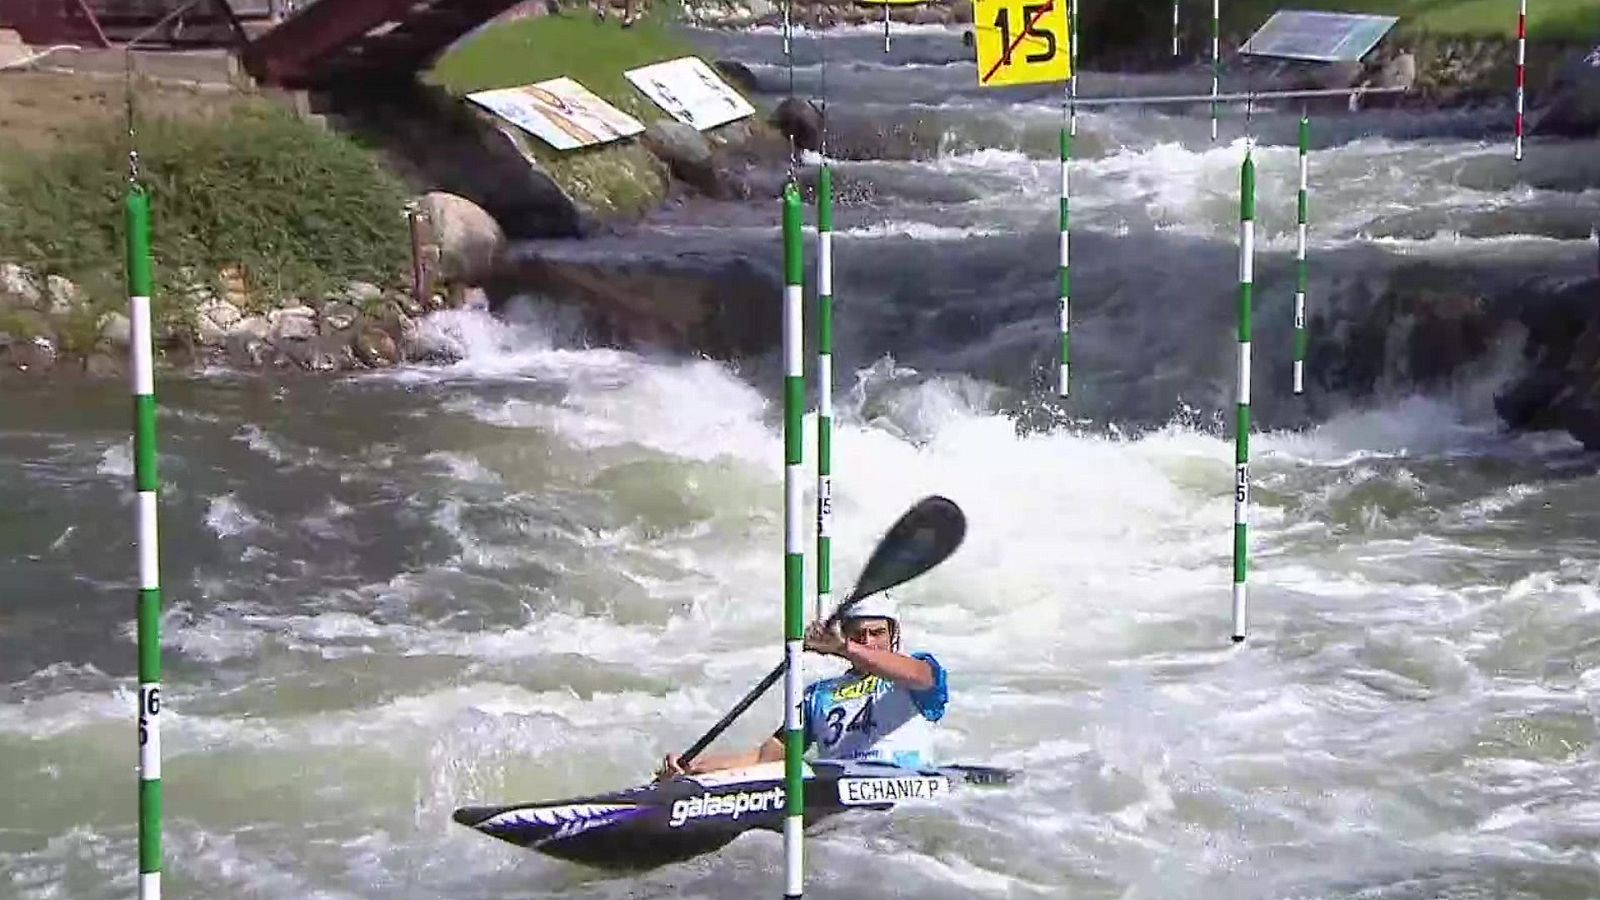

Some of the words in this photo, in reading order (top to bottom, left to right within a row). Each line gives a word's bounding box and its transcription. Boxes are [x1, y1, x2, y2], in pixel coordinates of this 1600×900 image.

[994, 5, 1056, 65] 15
[823, 696, 877, 745] 34
[669, 786, 787, 827] galasport
[848, 780, 924, 800] ECHANIZ
[929, 780, 938, 799] P
